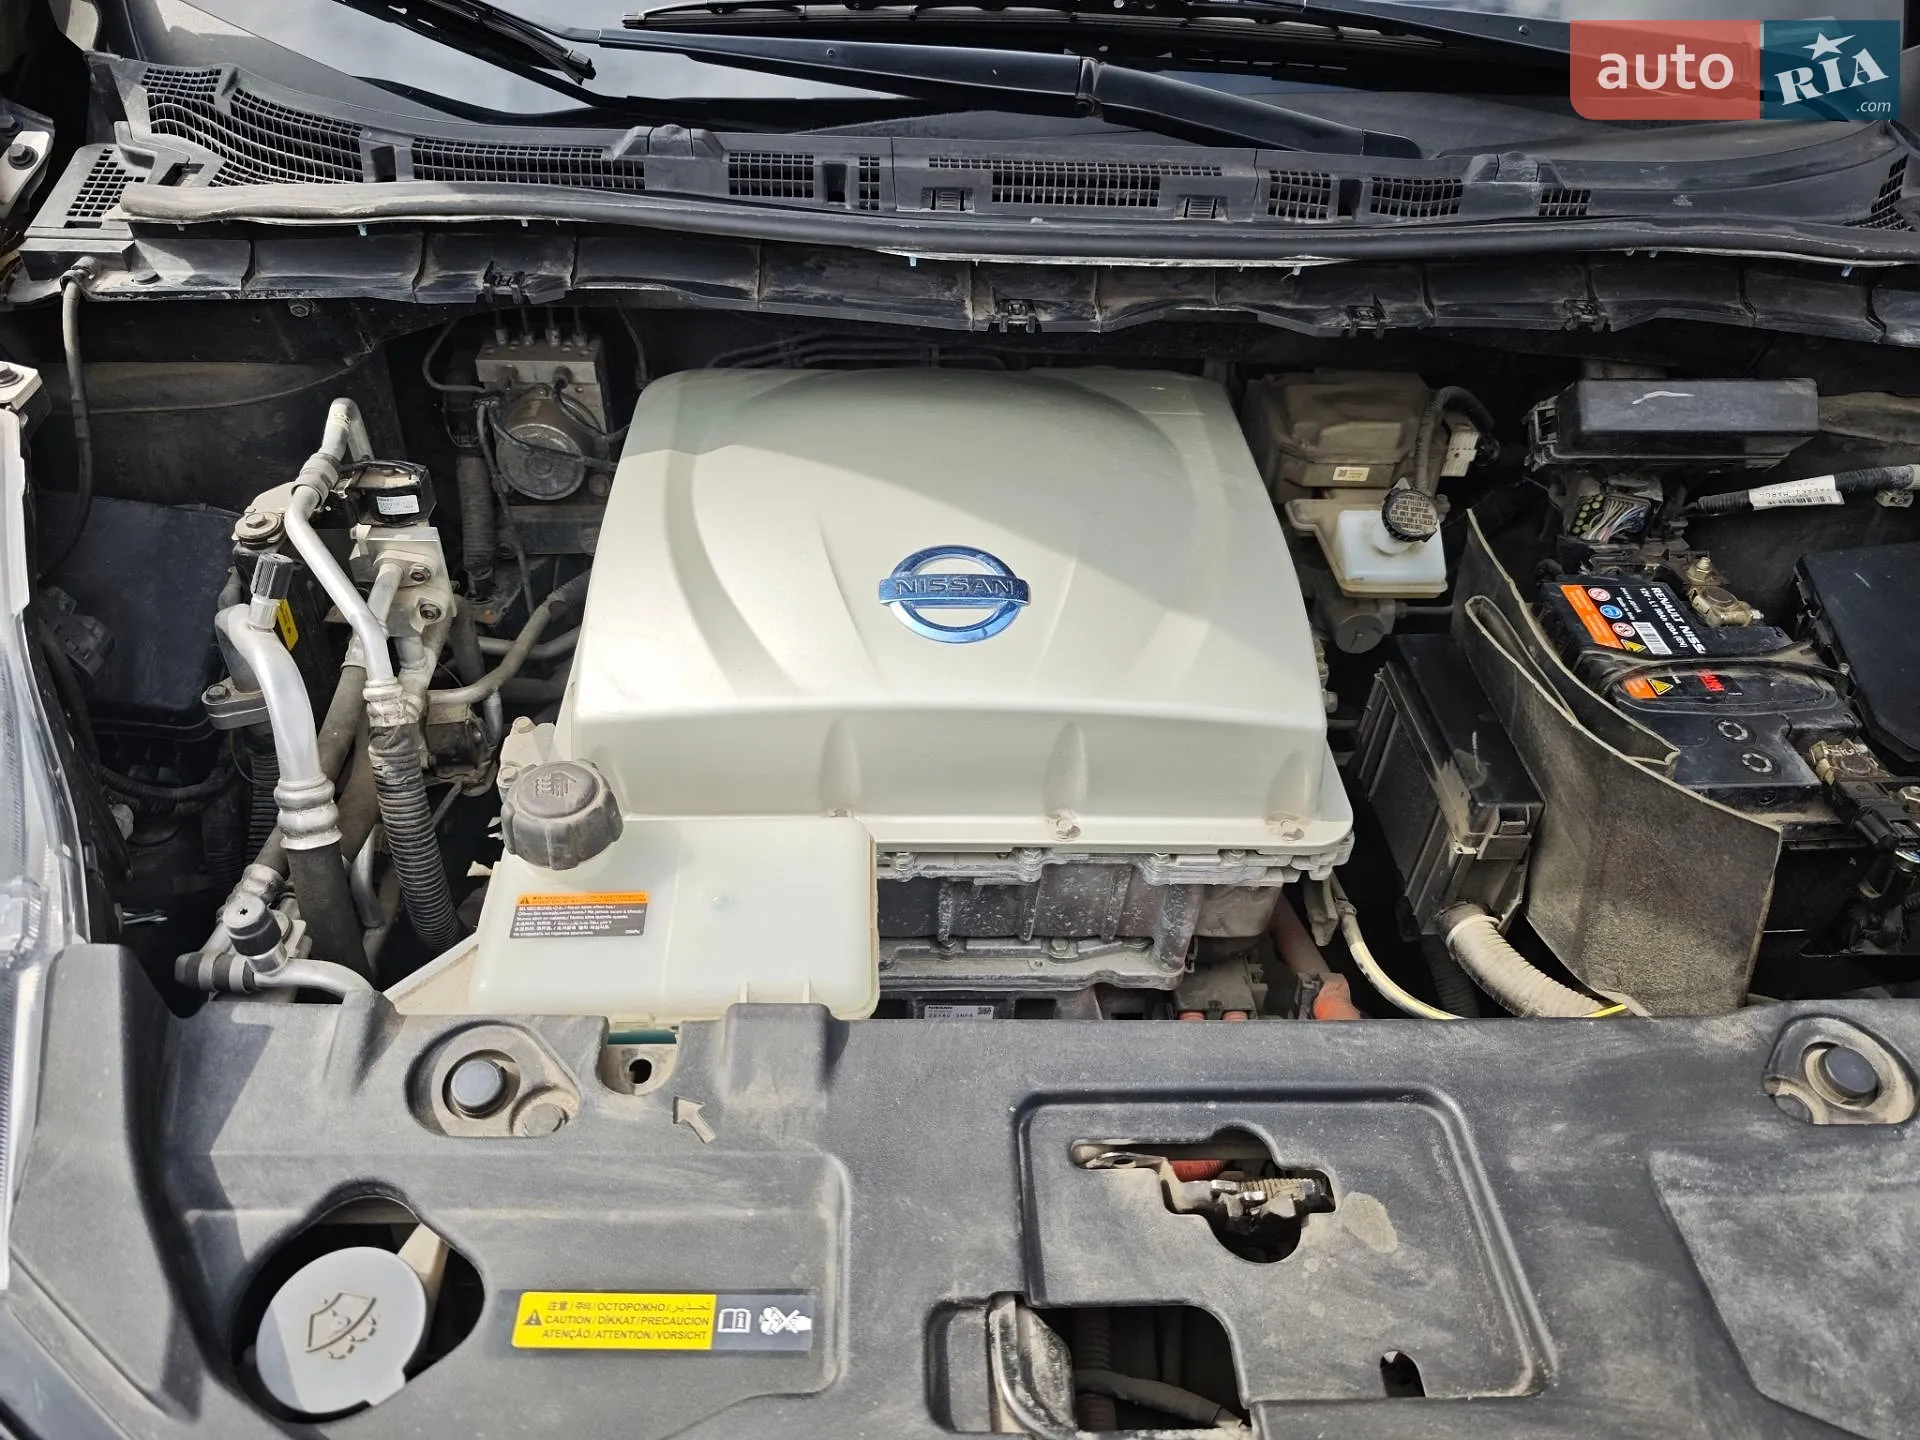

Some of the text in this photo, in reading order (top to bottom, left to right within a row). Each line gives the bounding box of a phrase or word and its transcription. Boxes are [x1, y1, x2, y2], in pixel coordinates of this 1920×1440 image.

[895, 577, 1015, 595] NISSAN
[1640, 587, 1651, 598] 12V
[1651, 587, 1707, 654] RENAULT NISS
[544, 1315, 591, 1325] CAUTION
[595, 1330, 651, 1339] ATTENTION
[656, 1330, 709, 1340] VORSICHT
